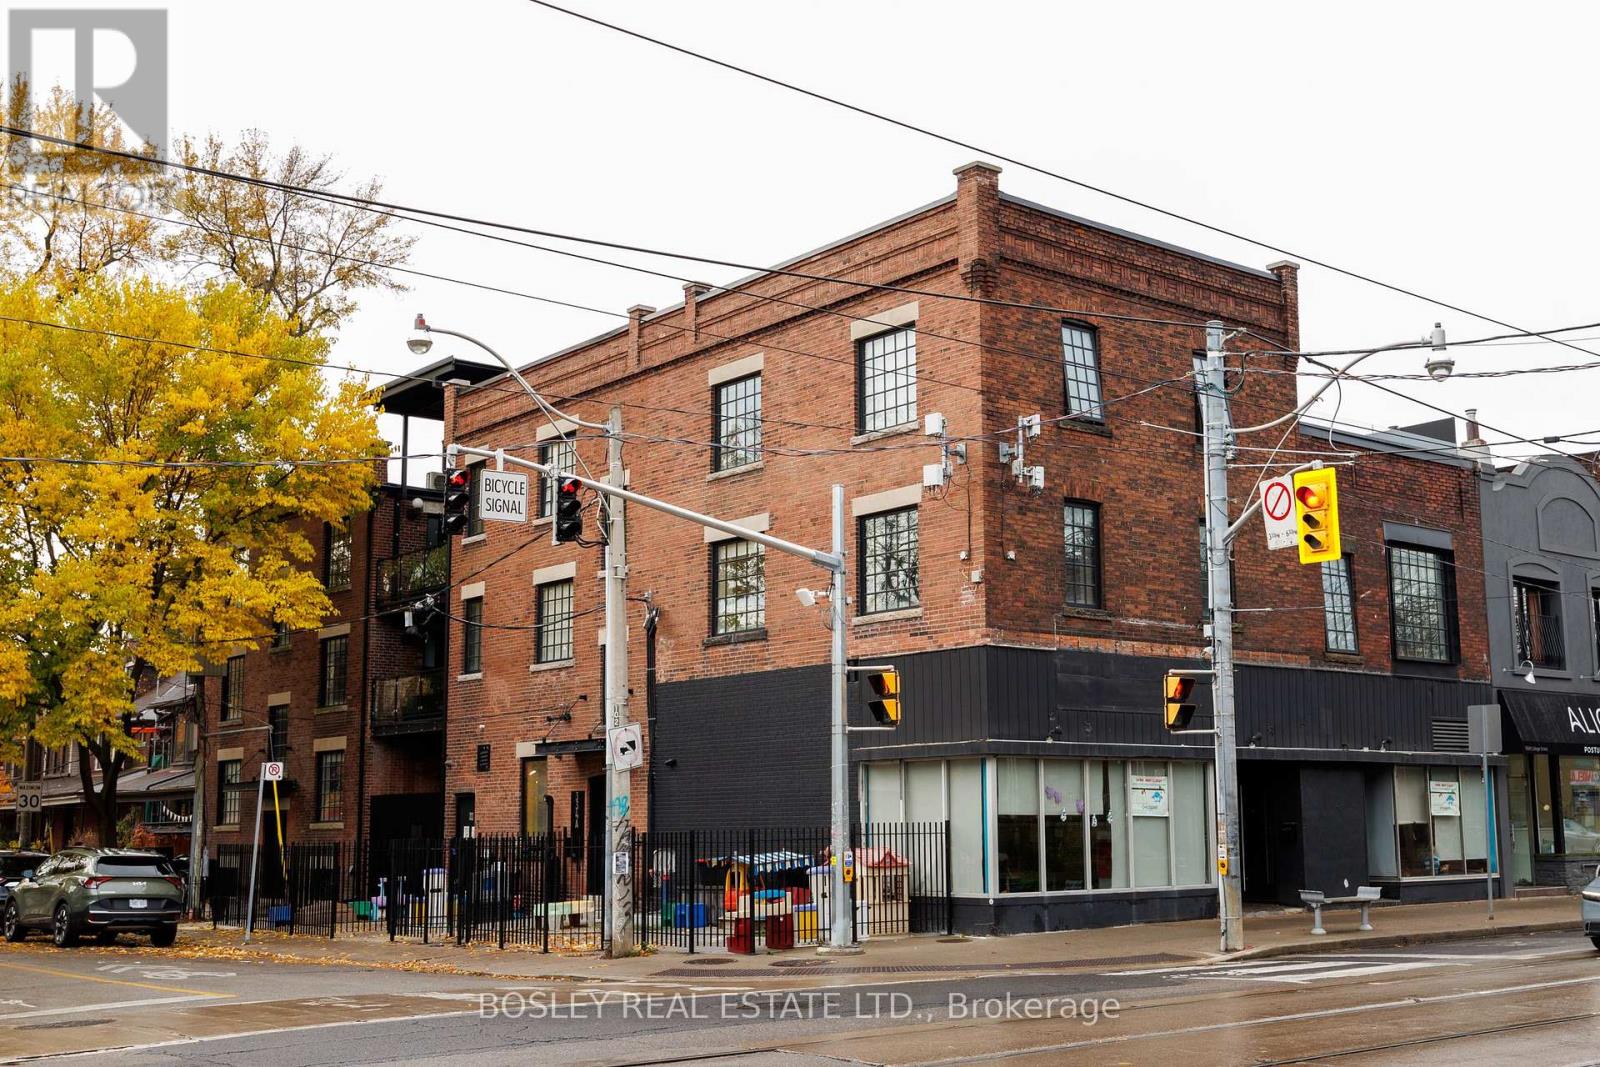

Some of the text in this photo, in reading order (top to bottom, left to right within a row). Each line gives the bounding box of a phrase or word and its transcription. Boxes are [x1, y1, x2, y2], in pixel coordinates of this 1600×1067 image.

[484, 477, 526, 496] BICYCLE
[485, 497, 524, 515] SIGNAL
[19, 795, 40, 808] 30
